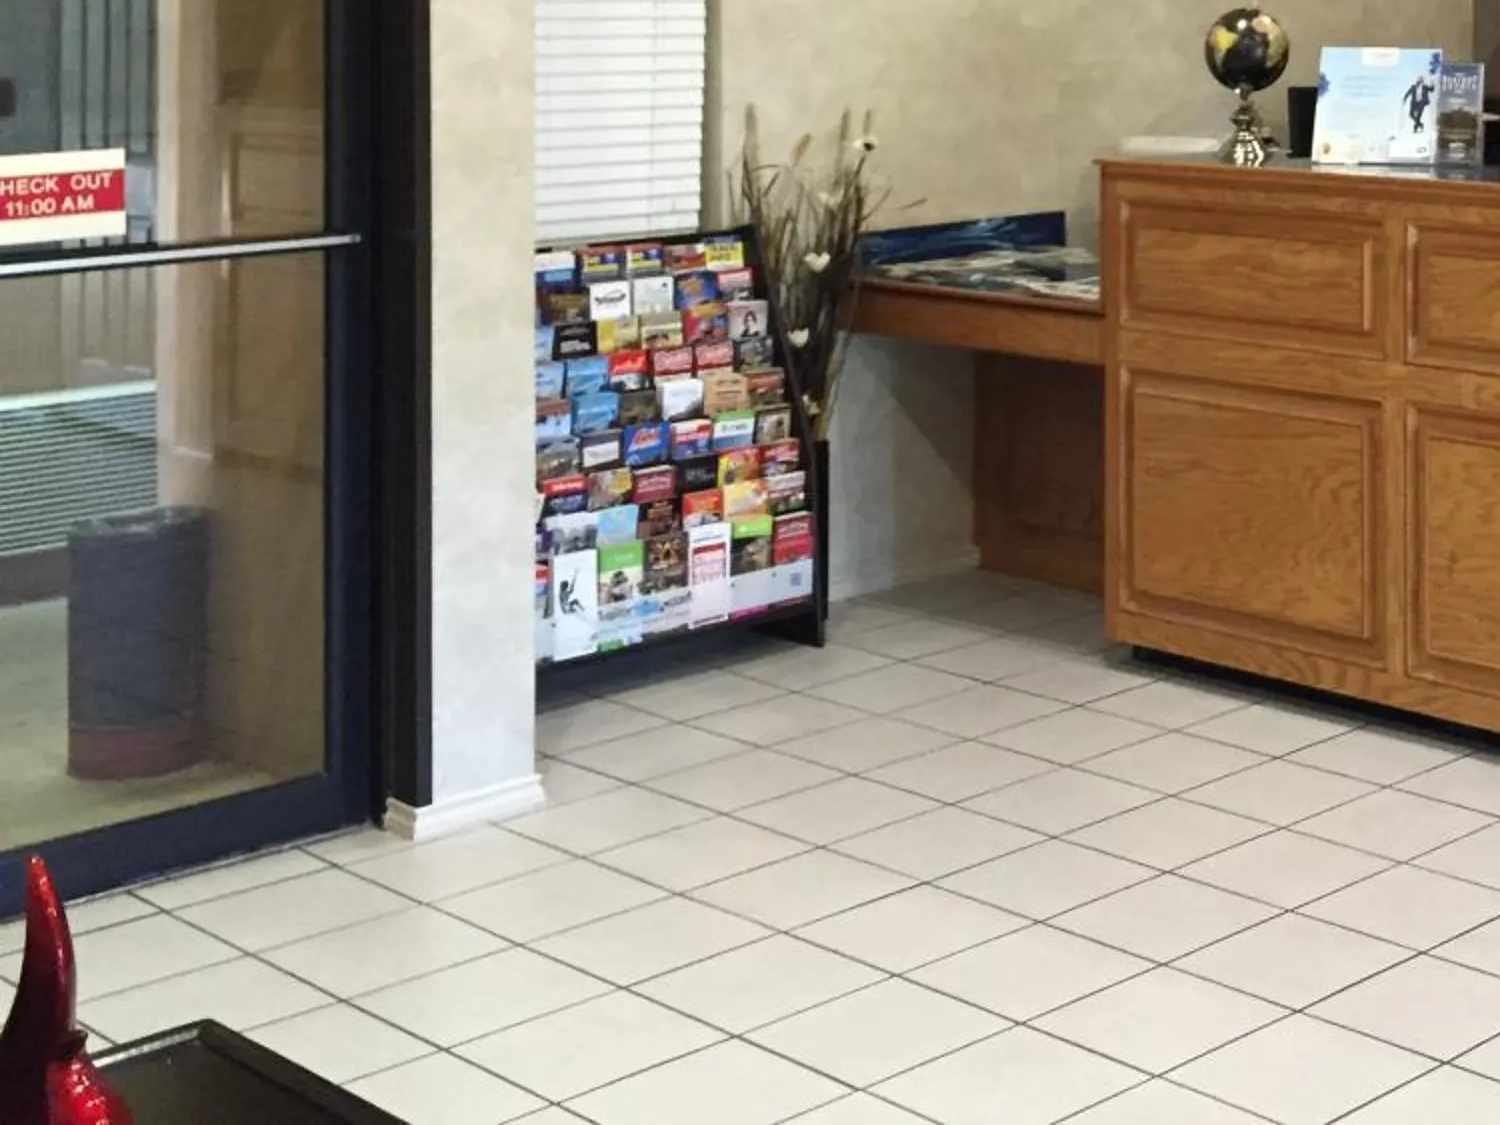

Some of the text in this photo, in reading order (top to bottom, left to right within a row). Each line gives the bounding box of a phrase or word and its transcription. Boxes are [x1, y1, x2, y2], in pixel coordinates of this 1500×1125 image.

[0, 172, 112, 195] HECK OUT
[6, 194, 95, 216] 11:00 AM
